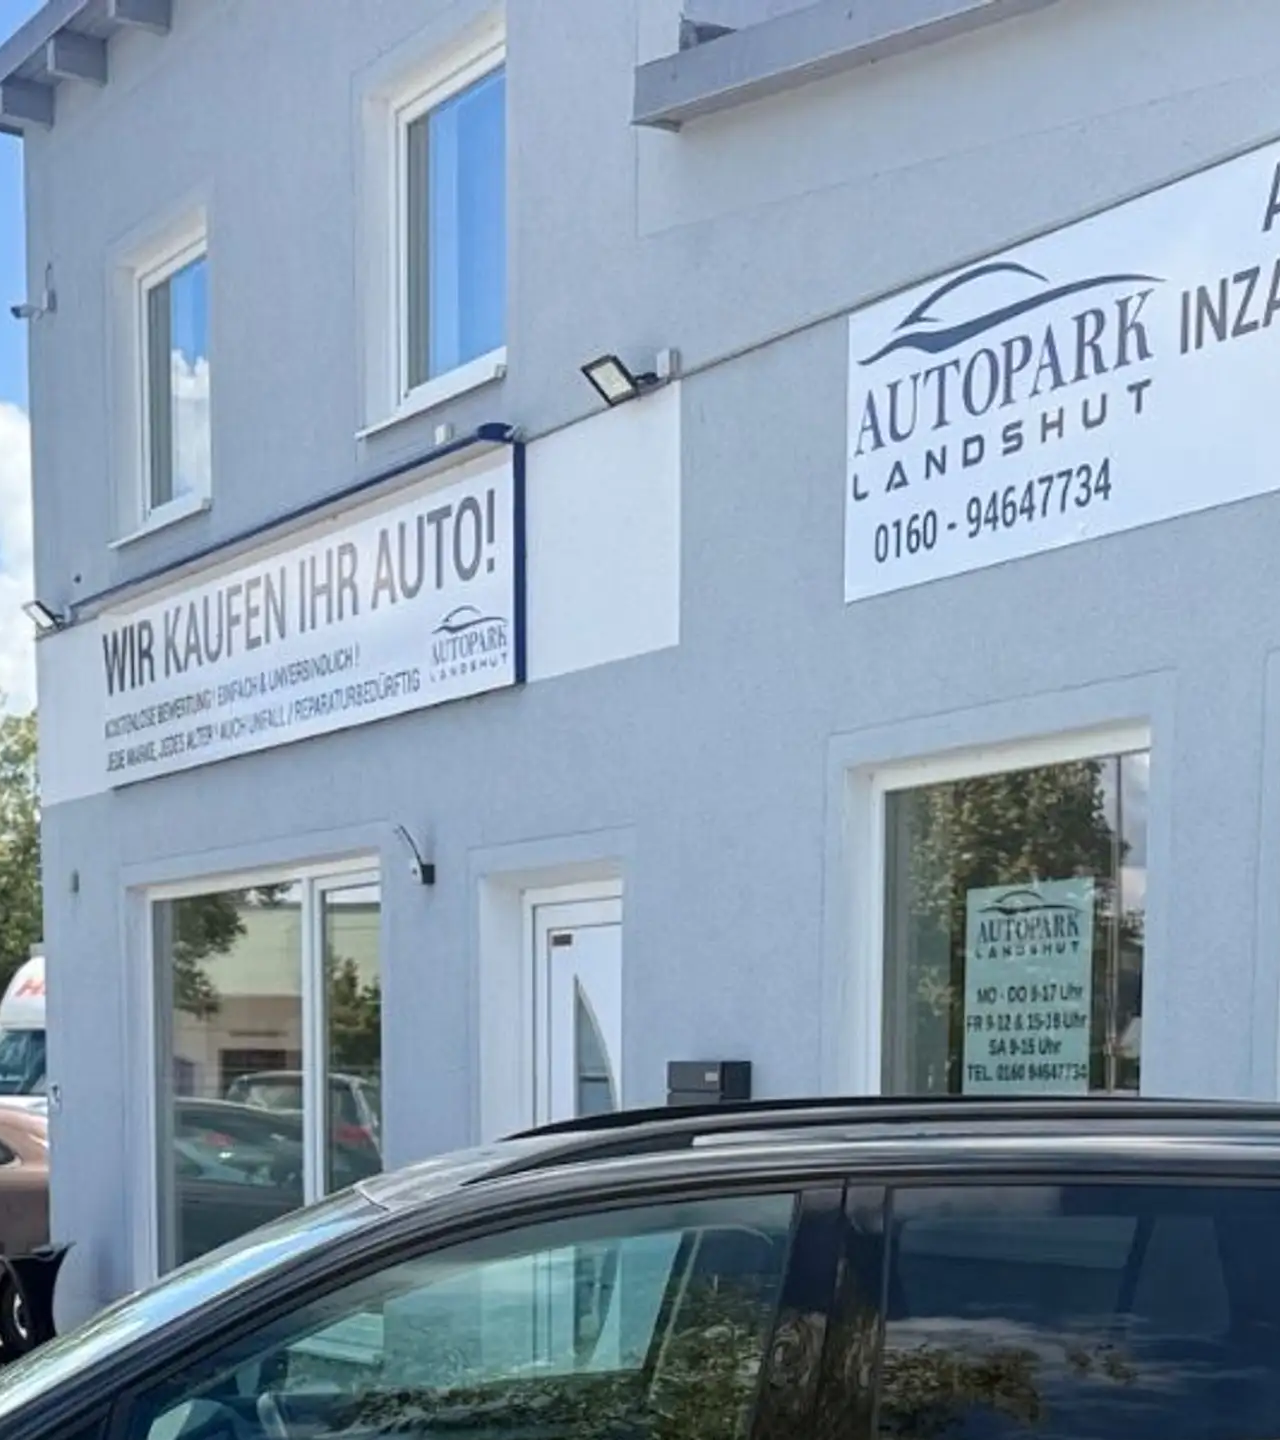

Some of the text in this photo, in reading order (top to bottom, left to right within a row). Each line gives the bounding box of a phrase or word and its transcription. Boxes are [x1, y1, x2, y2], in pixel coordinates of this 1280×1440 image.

[854, 288, 1156, 456] AUTOPARK
[853, 379, 1152, 502] LANDSHUT
[874, 509, 937, 563] 0160
[966, 457, 1112, 538] 94647734
[102, 488, 497, 697] WIR KAUFEN IHR AUTO!
[432, 623, 508, 666] AUTOPARK
[430, 652, 508, 683] LANDSHUT
[977, 913, 1080, 944] AUTOPARK
[974, 941, 1079, 960] LANDSHUT
[976, 986, 997, 1004] MO
[1007, 985, 1027, 1004] DO
[1060, 981, 1083, 1001] Uhr
[967, 1014, 983, 1033] FR
[1063, 1010, 1087, 1029] Uhr
[988, 1037, 1006, 1057] SA
[1038, 1036, 1062, 1055] Uhr
